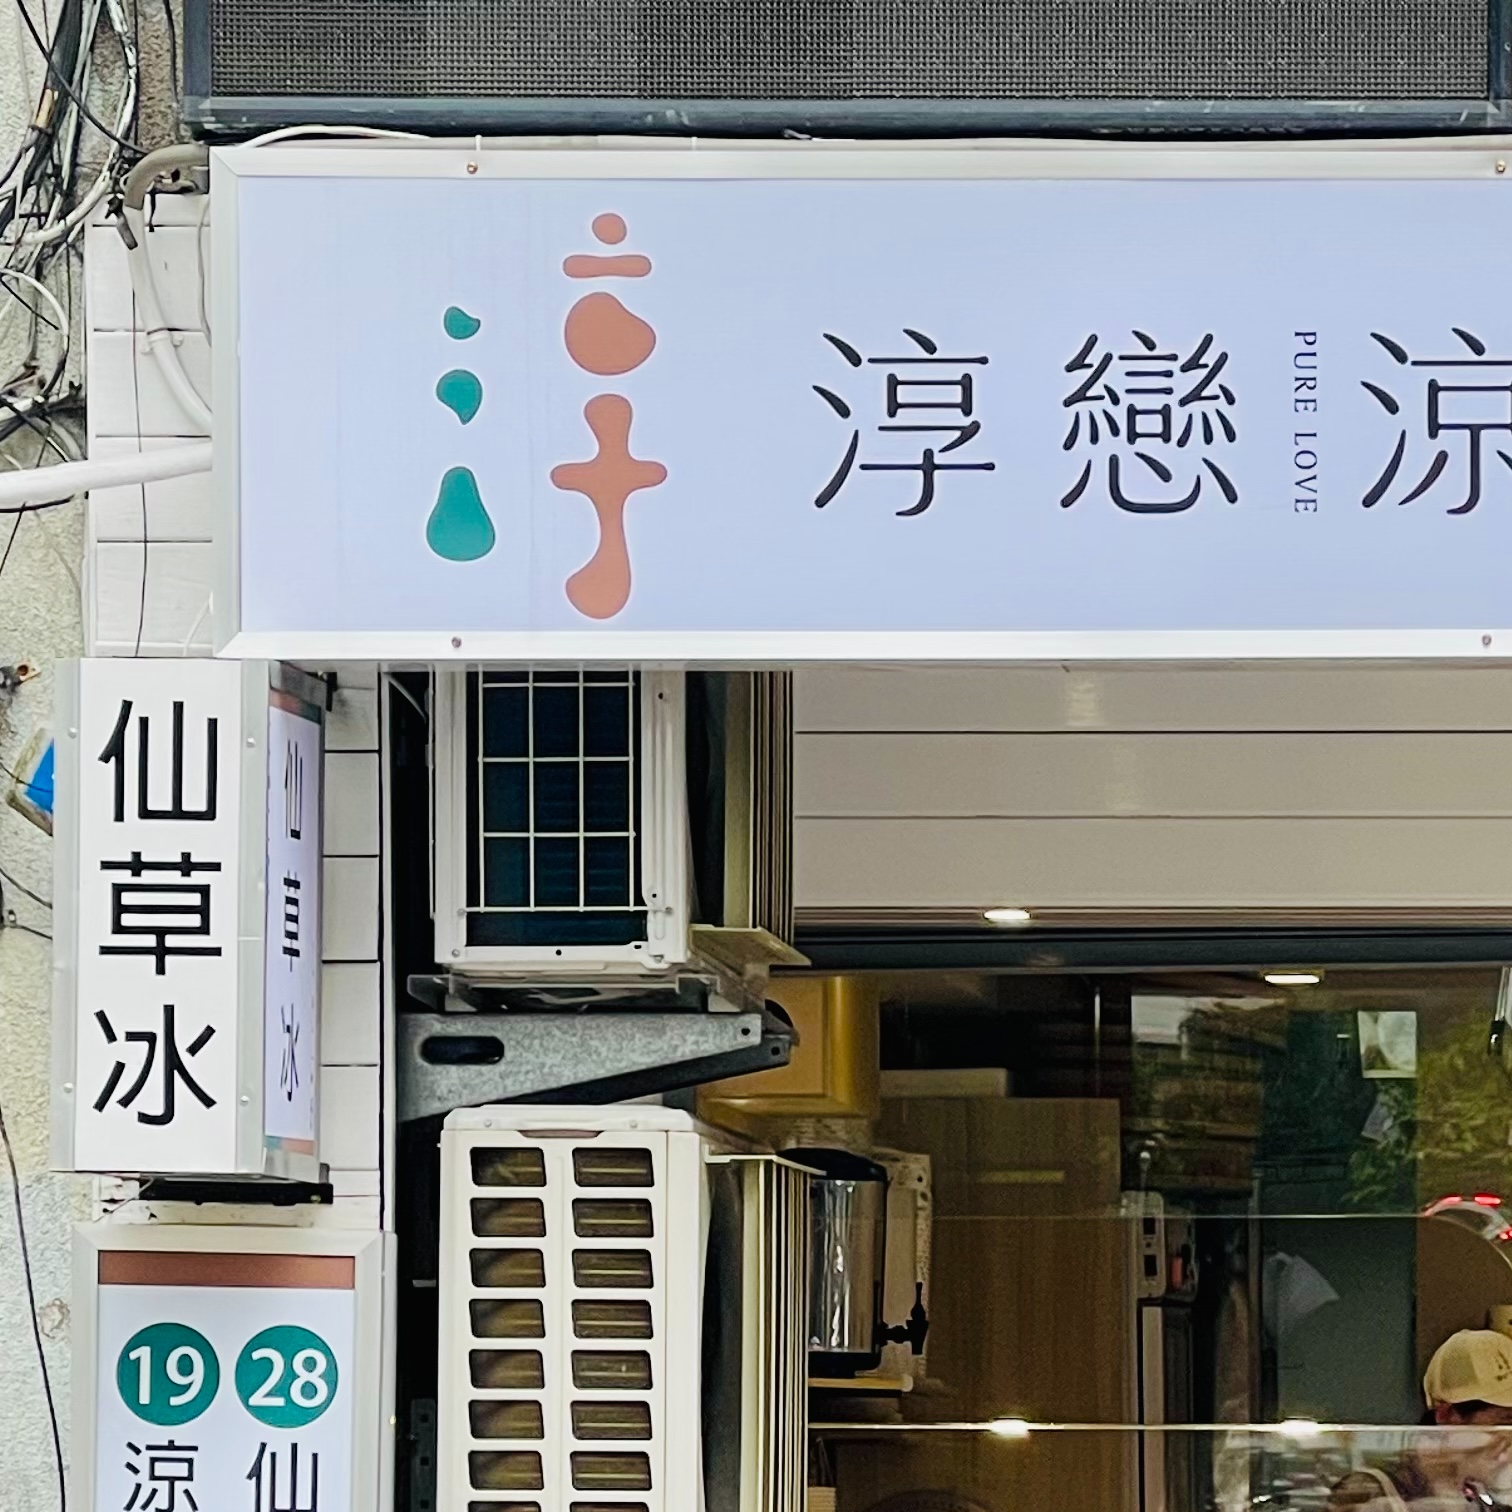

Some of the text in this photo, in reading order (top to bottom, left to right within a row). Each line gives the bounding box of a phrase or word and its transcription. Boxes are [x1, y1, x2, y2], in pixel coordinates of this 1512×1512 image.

[1293, 331, 1318, 513] PURE LOVE
[93, 699, 222, 1126] 仙草冰
[127, 1345, 205, 1406] 19
[248, 1347, 330, 1408] 28
